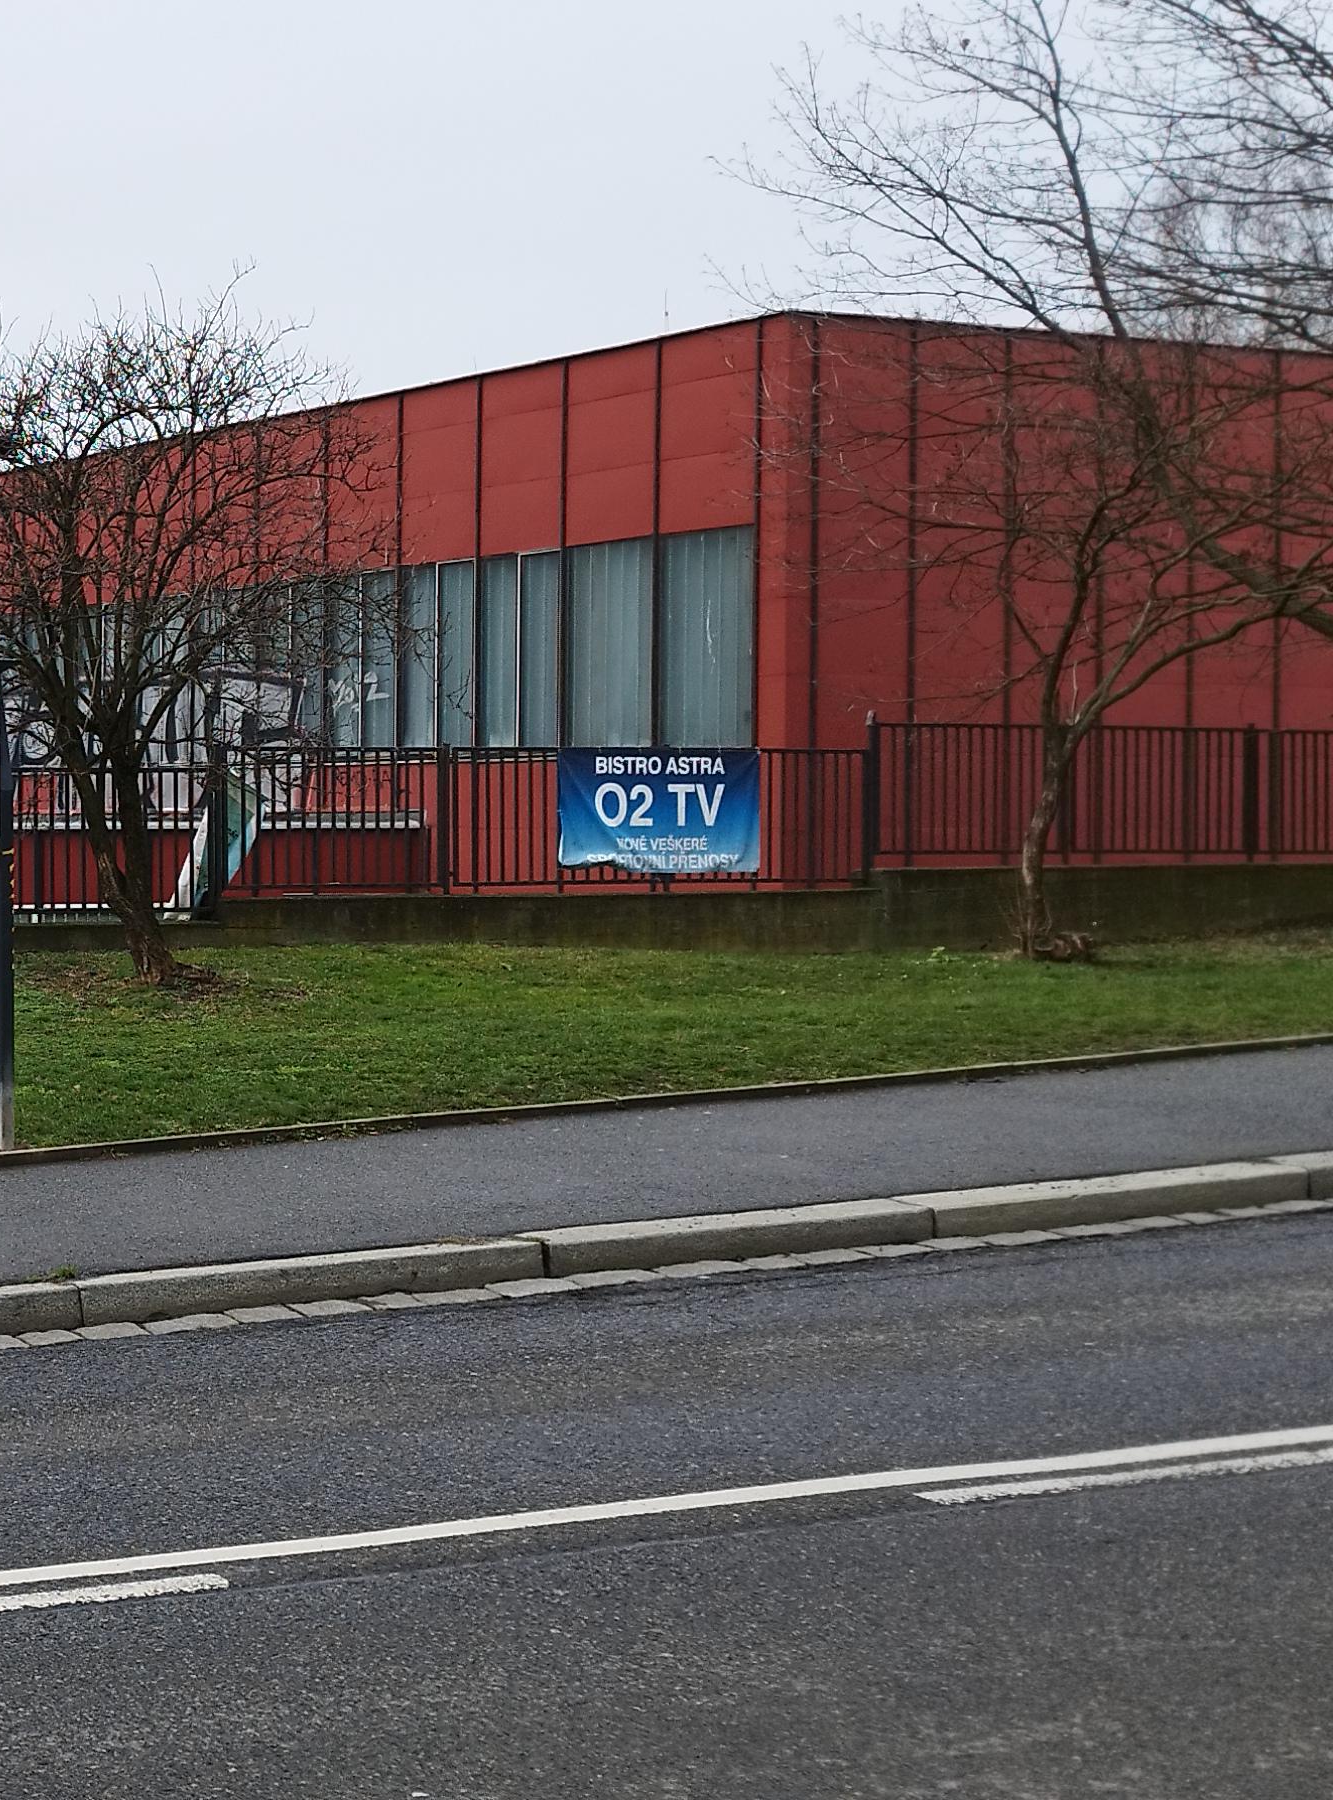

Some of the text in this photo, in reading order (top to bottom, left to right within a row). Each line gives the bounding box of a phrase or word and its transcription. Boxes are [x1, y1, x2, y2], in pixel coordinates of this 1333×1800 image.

[595, 756, 726, 775] BISTRO ASTRA
[594, 782, 726, 828] O2 TV
